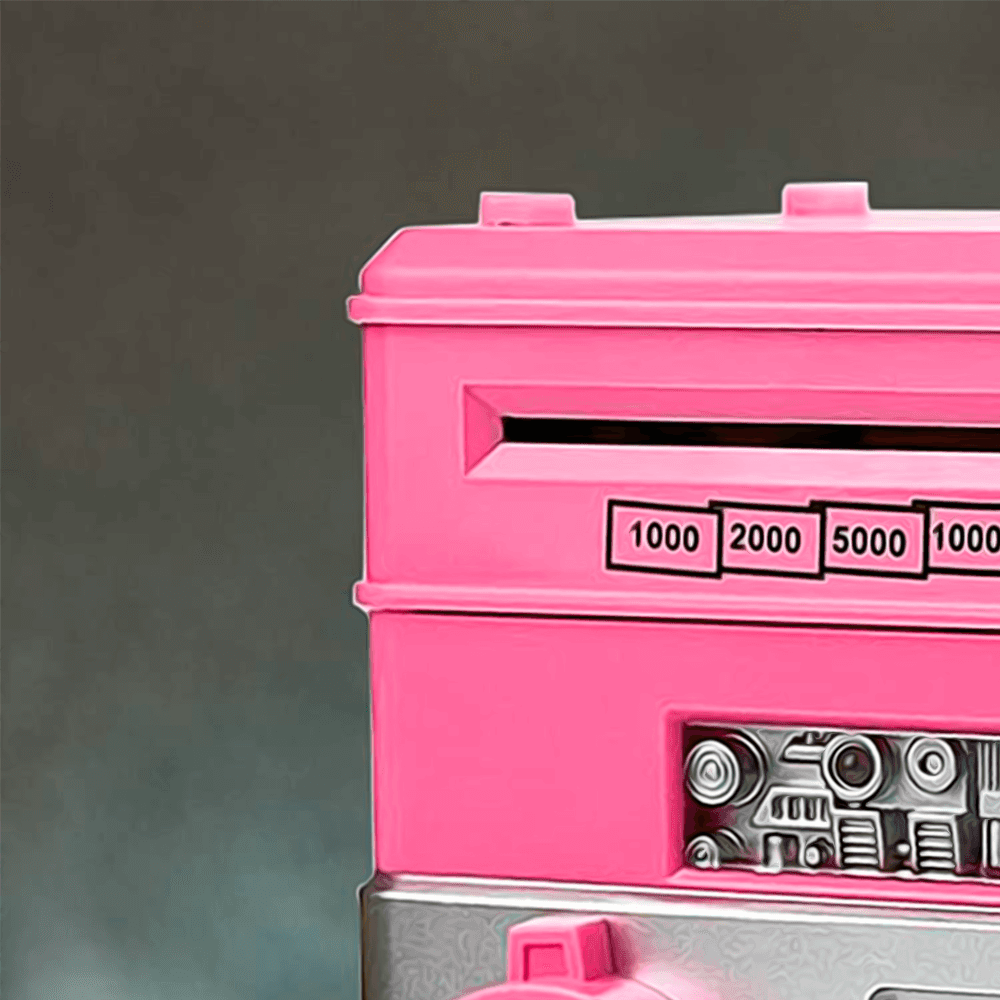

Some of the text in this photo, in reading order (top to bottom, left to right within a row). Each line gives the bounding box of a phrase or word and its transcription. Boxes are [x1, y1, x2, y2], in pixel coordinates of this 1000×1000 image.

[630, 520, 700, 552] 1000
[730, 522, 802, 554] 2000
[832, 525, 907, 558] 5000
